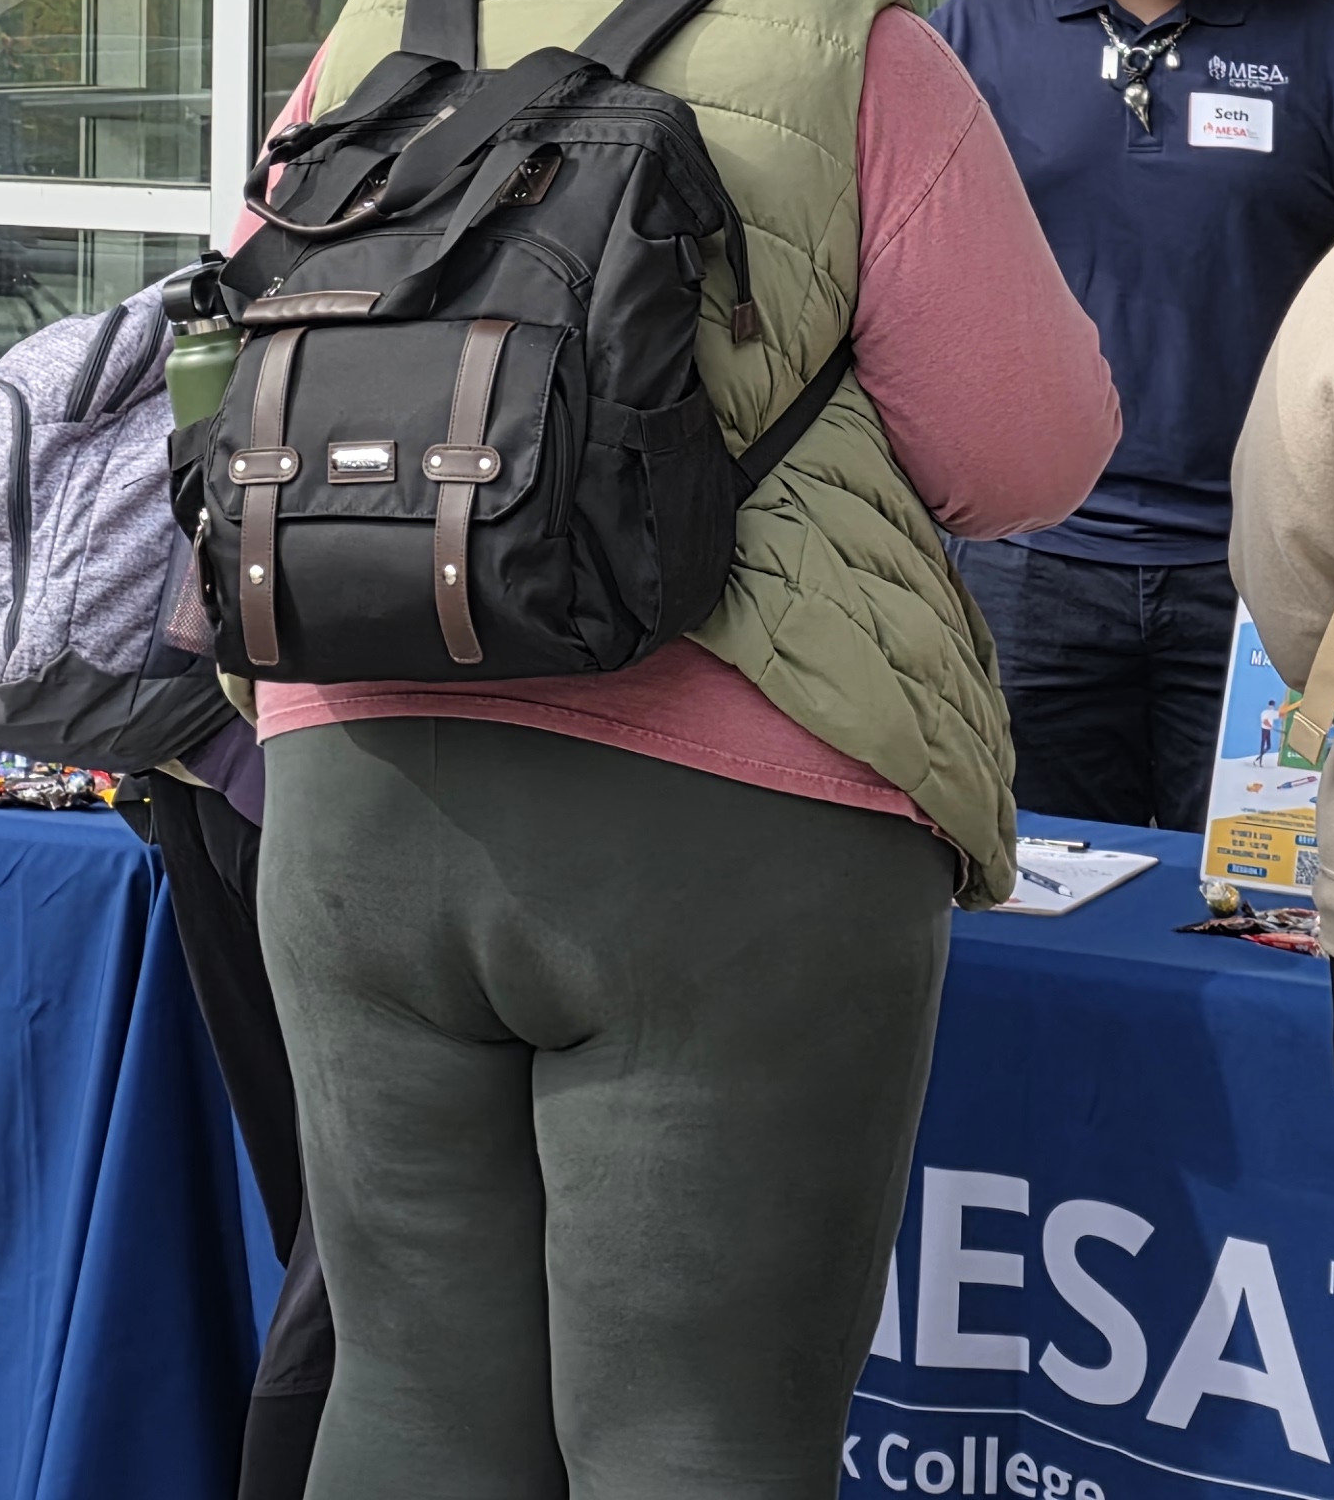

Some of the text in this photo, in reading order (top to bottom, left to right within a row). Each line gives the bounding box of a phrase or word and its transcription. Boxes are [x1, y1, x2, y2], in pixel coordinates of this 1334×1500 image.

[1229, 61, 1285, 82] MESA
[1215, 107, 1249, 122] Seth
[870, 1166, 1331, 1464] ESA
